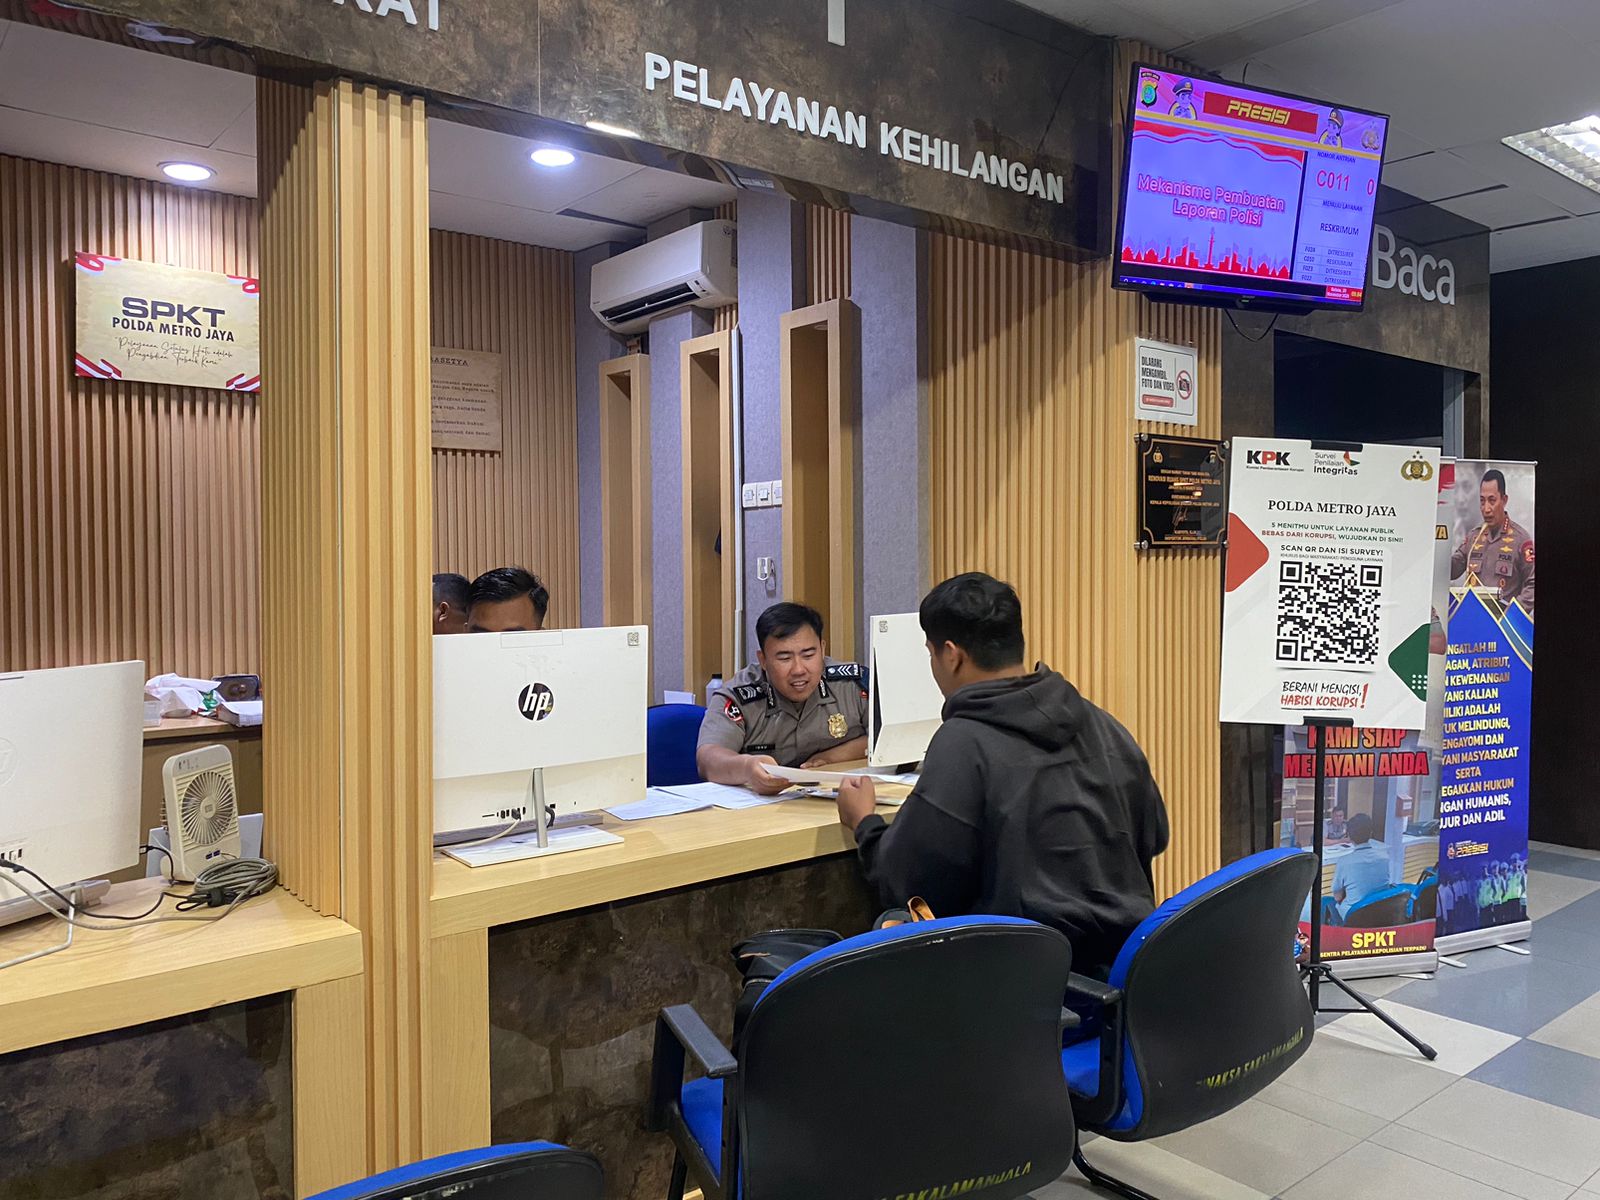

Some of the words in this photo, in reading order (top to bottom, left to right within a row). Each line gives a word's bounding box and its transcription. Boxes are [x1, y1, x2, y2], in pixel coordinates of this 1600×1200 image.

[1226, 99, 1291, 126] PRESISI
[645, 52, 866, 148] PELAYANAN
[880, 122, 1064, 203] KEHILANGAN
[1316, 170, 1350, 191] C011
[1137, 173, 1211, 200] Mekanisme
[1214, 186, 1286, 211] Pembuatan
[1172, 200, 1226, 222] Laporan
[1229, 207, 1263, 227] Polisi
[1320, 223, 1359, 236] RESKRIMUM
[1372, 223, 1455, 305] Baca
[122, 297, 226, 328] SPKT
[112, 317, 155, 333] POLDA
[159, 322, 202, 338] METRO
[205, 329, 235, 342] JAYA
[431, 357, 469, 368] ASETYA
[1142, 356, 1162, 368] DILARANG
[1142, 367, 1167, 380] MENGAMBIL
[1142, 378, 1153, 388] FOTO
[1154, 379, 1162, 389] DAN
[1163, 381, 1175, 391] VIDEO
[1247, 450, 1290, 466] KPK
[1313, 466, 1358, 476] Integritas
[1268, 500, 1313, 513] POLDA
[1316, 502, 1363, 515] METRO
[1366, 503, 1397, 518] JAYA
[1278, 522, 1309, 530] MENITMU
[1336, 525, 1369, 533] LAYANAN
[1304, 532, 1337, 540] KORUPSI,
[1338, 534, 1377, 542] WUJUDKAN
[1280, 544, 1303, 552] SCAN
[1318, 546, 1336, 554] DAN
[1349, 548, 1384, 556] SURVEY!
[1472, 656, 1511, 669] ATRIBUT,
[1450, 672, 1511, 686] KEWENANGAN
[1282, 681, 1318, 693] BERANI
[1320, 683, 1362, 696] MENGISI,
[1465, 688, 1499, 700] KALIAN
[518, 682, 554, 721] hp
[1281, 694, 1313, 706] HABISI
[1315, 696, 1359, 708] KORUPSI
[1464, 703, 1501, 716] ADALAH
[1443, 722, 1457, 734] UK
[1458, 717, 1511, 732] MELINDUNGI,
[1362, 727, 1407, 749] SIAP
[1442, 735, 1484, 750] ENGAYOMI
[1485, 733, 1505, 746] DAN
[1377, 751, 1430, 777] ANDA
[1461, 747, 1520, 764] MASYARAKAT
[1455, 766, 1482, 780] SERTA
[1441, 781, 1482, 797] EGAKKAN
[1483, 777, 1515, 791] HUKUM
[1465, 793, 1512, 810] HUMANIS,
[1462, 813, 1482, 826] DAN
[1484, 809, 1506, 823] ADIL
[1351, 930, 1397, 949] SPKT
[1341, 949, 1371, 957] PELAYANAN
